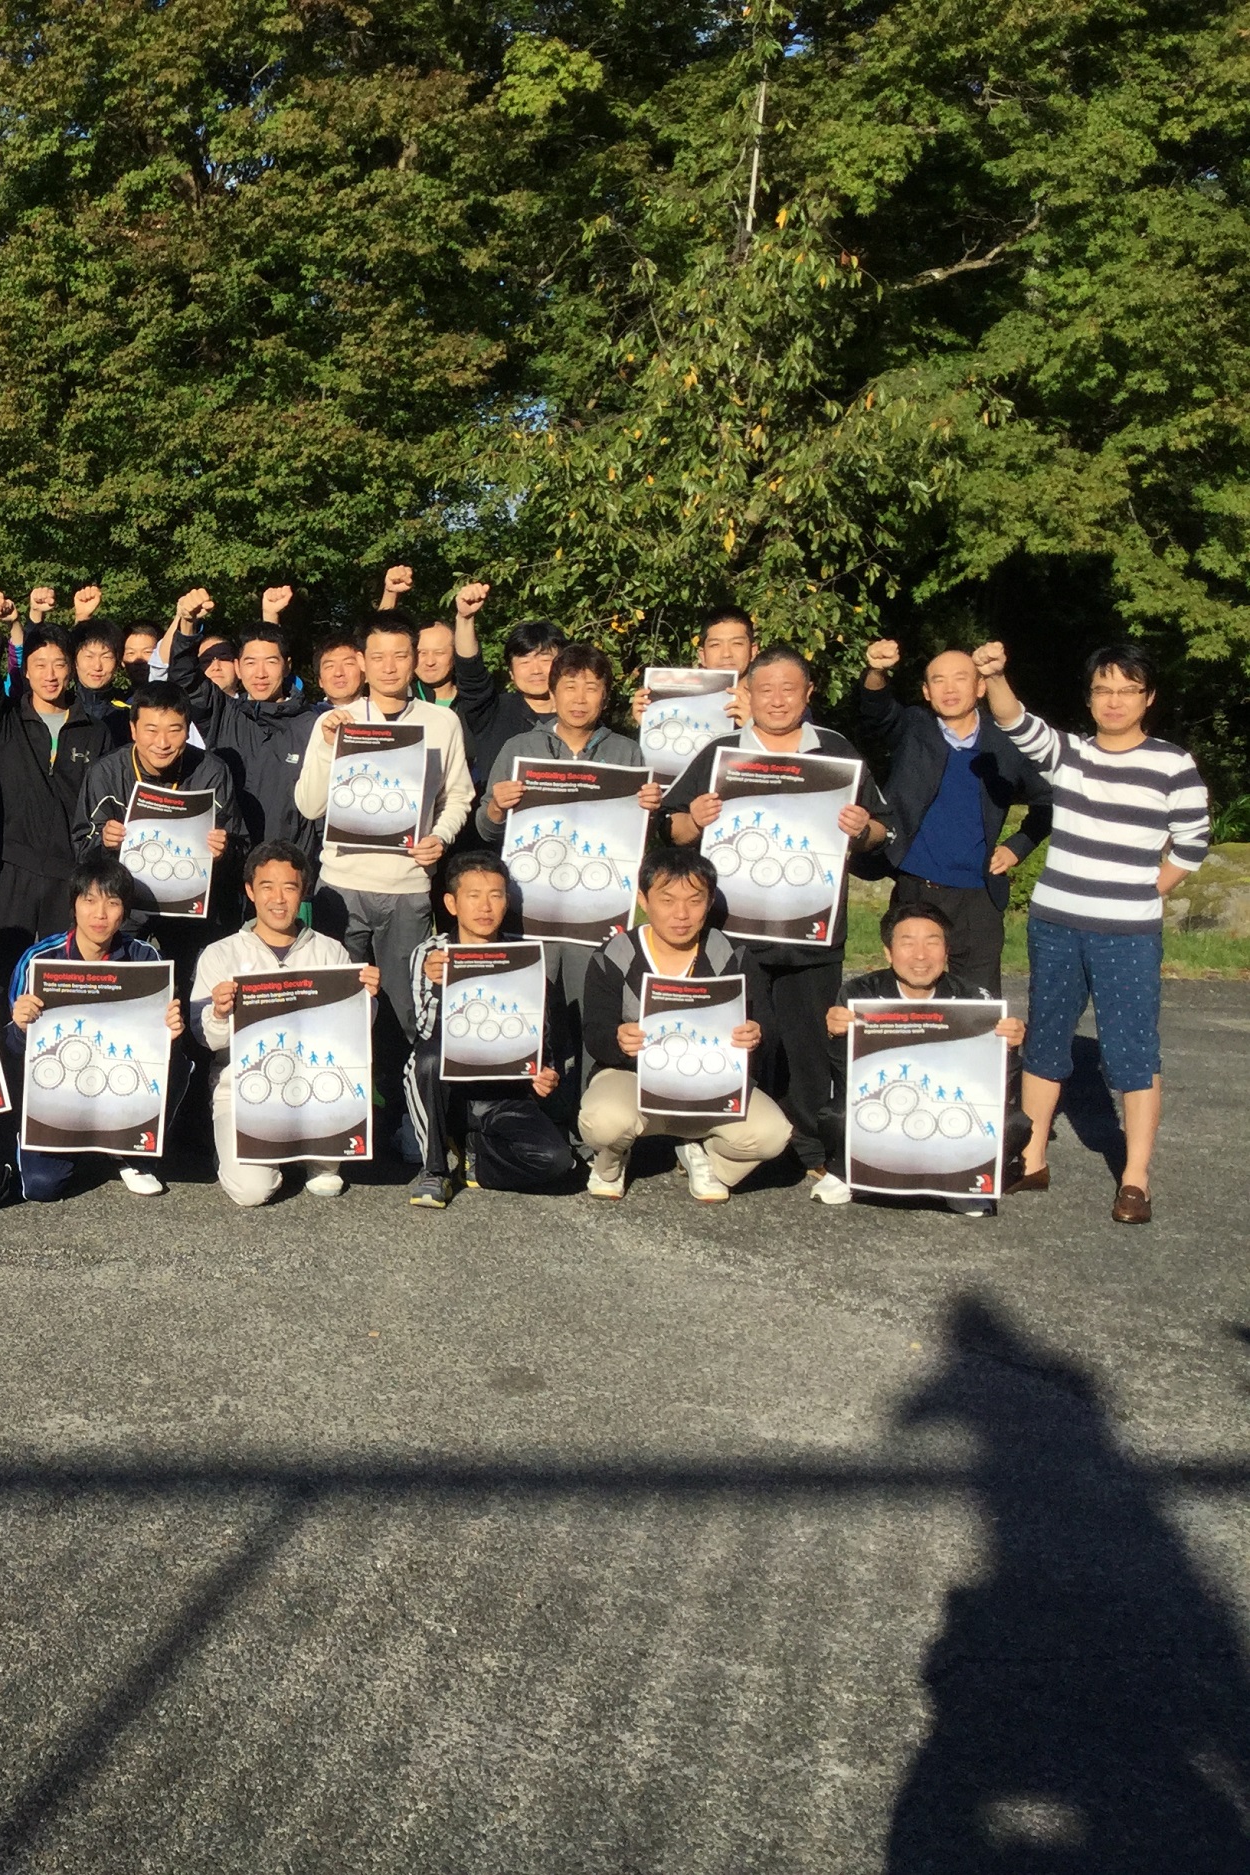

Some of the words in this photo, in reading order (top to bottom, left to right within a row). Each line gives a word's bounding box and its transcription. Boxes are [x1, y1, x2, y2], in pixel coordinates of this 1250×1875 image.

[526, 770, 566, 781] Negotiating
[567, 773, 597, 782] Security
[43, 973, 85, 982] Negotiating
[86, 974, 117, 983] Security
